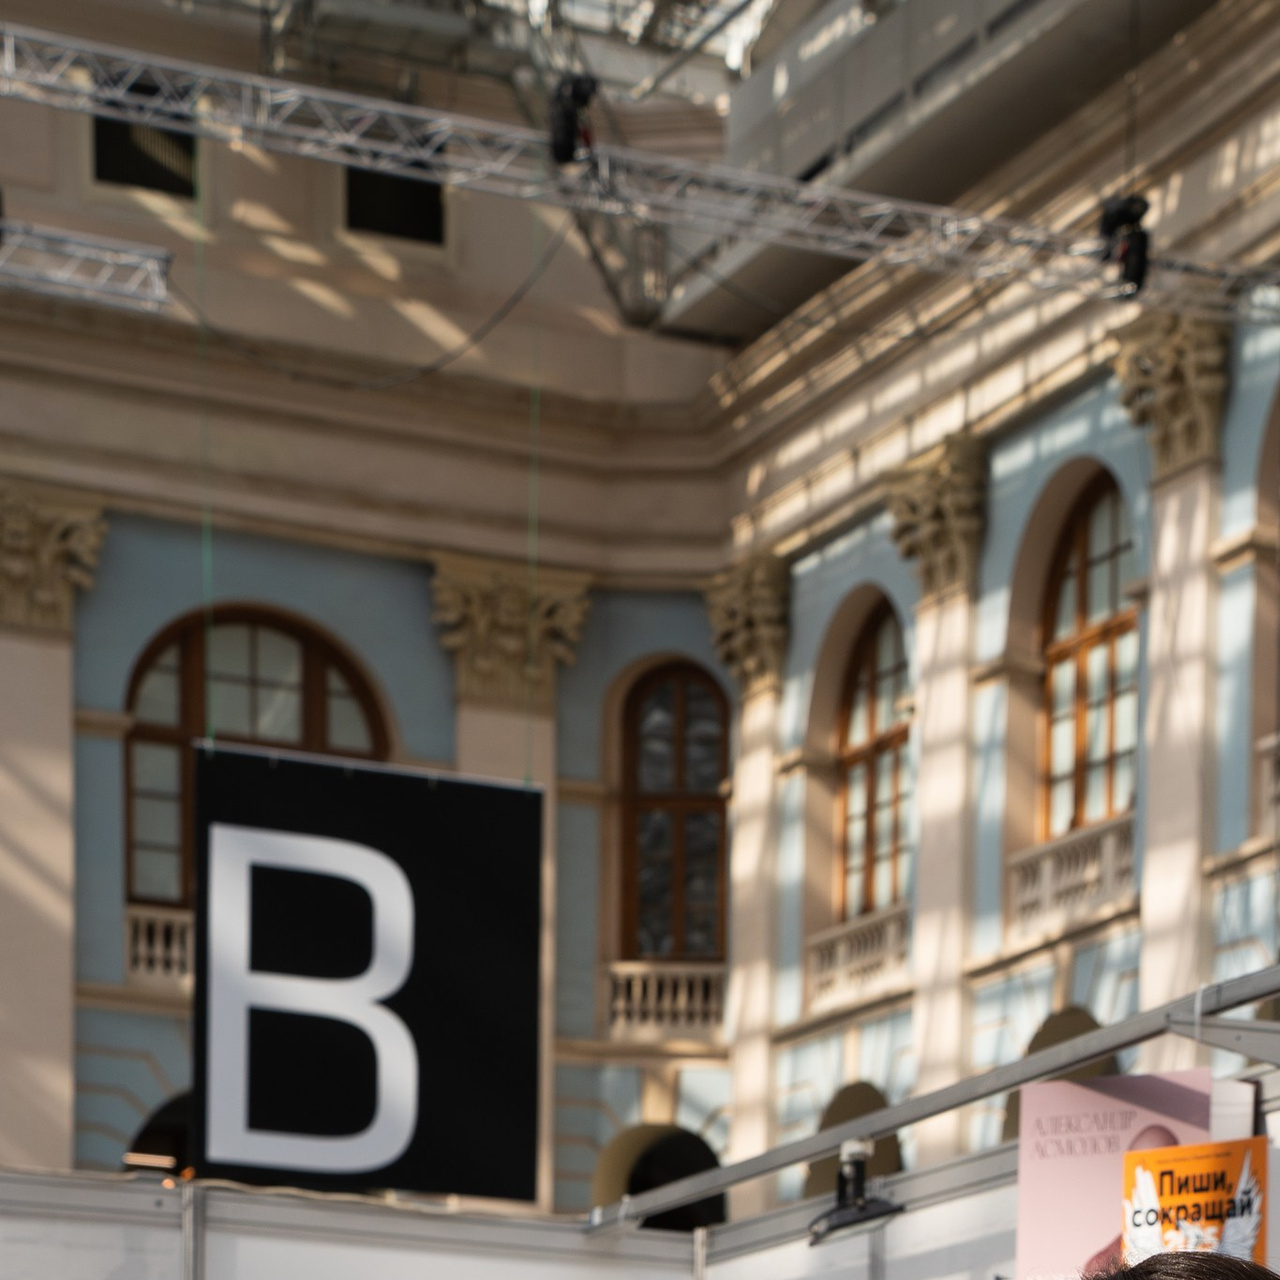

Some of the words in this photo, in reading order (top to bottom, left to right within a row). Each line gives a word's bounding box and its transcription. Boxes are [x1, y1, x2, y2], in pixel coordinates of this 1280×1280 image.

[1031, 1110, 1137, 1137] АЛЕКСАНДР
[1033, 1134, 1121, 1160] АСМОЛОВ
[1159, 1169, 1233, 1197] Пиши,
[1132, 1188, 1253, 1230] сокращай
